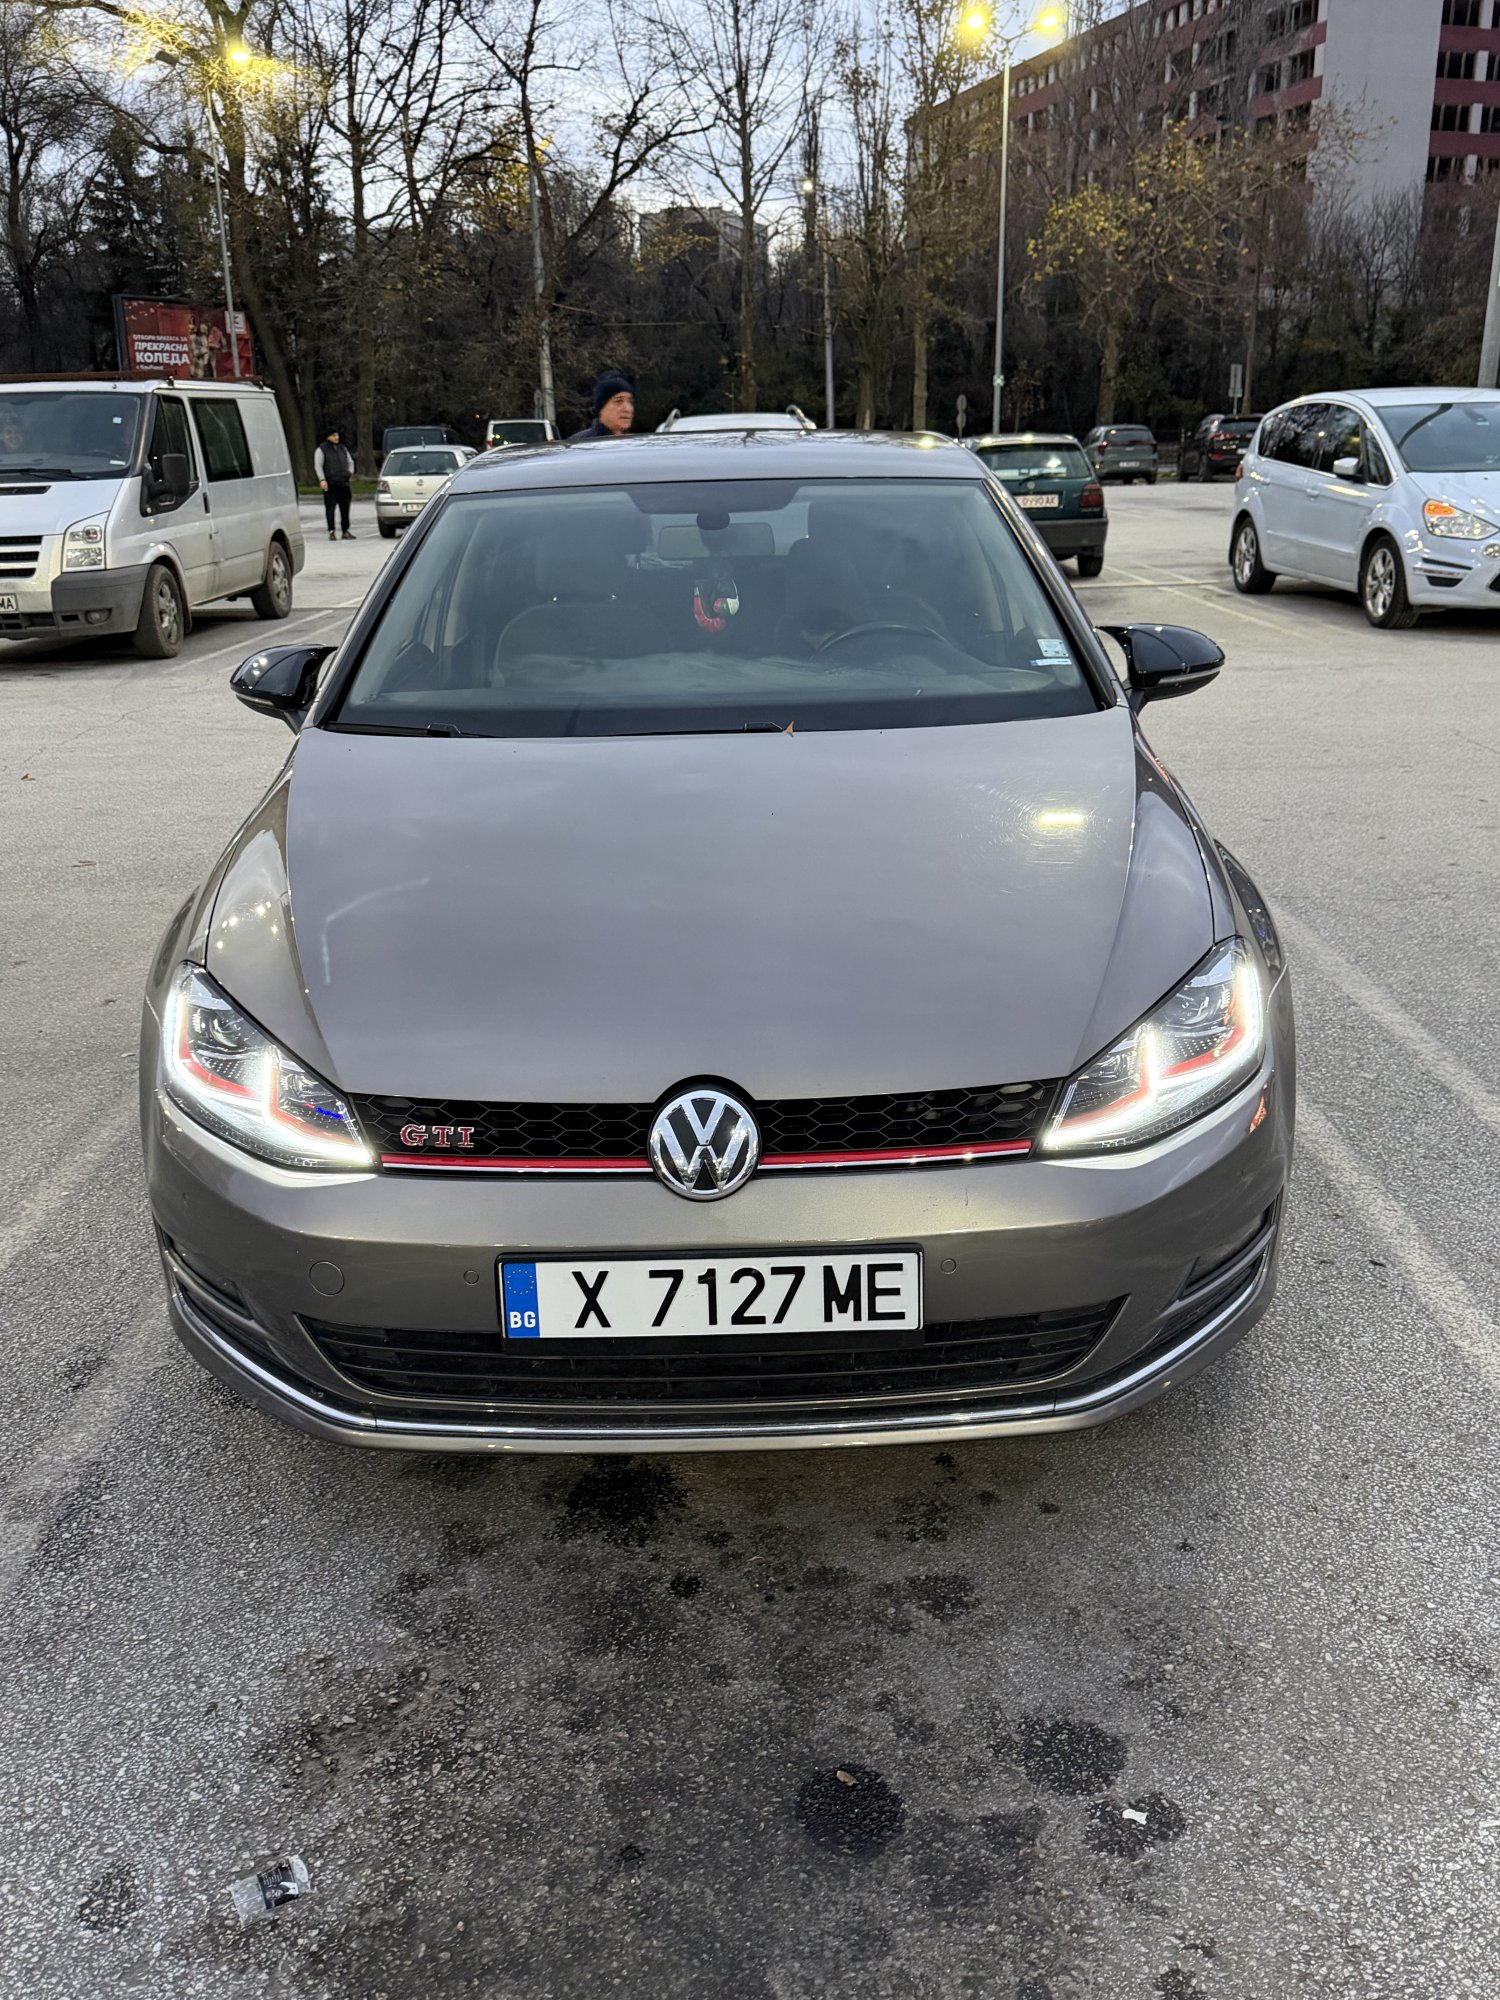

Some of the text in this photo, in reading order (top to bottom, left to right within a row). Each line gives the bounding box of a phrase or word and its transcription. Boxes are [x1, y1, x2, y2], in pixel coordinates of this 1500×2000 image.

[134, 342, 189, 352] ПРЕКРАСНА
[135, 352, 190, 366] КОЛЕДА
[400, 1124, 475, 1147] GTI
[509, 1263, 906, 1329] BG X 7127 ME
